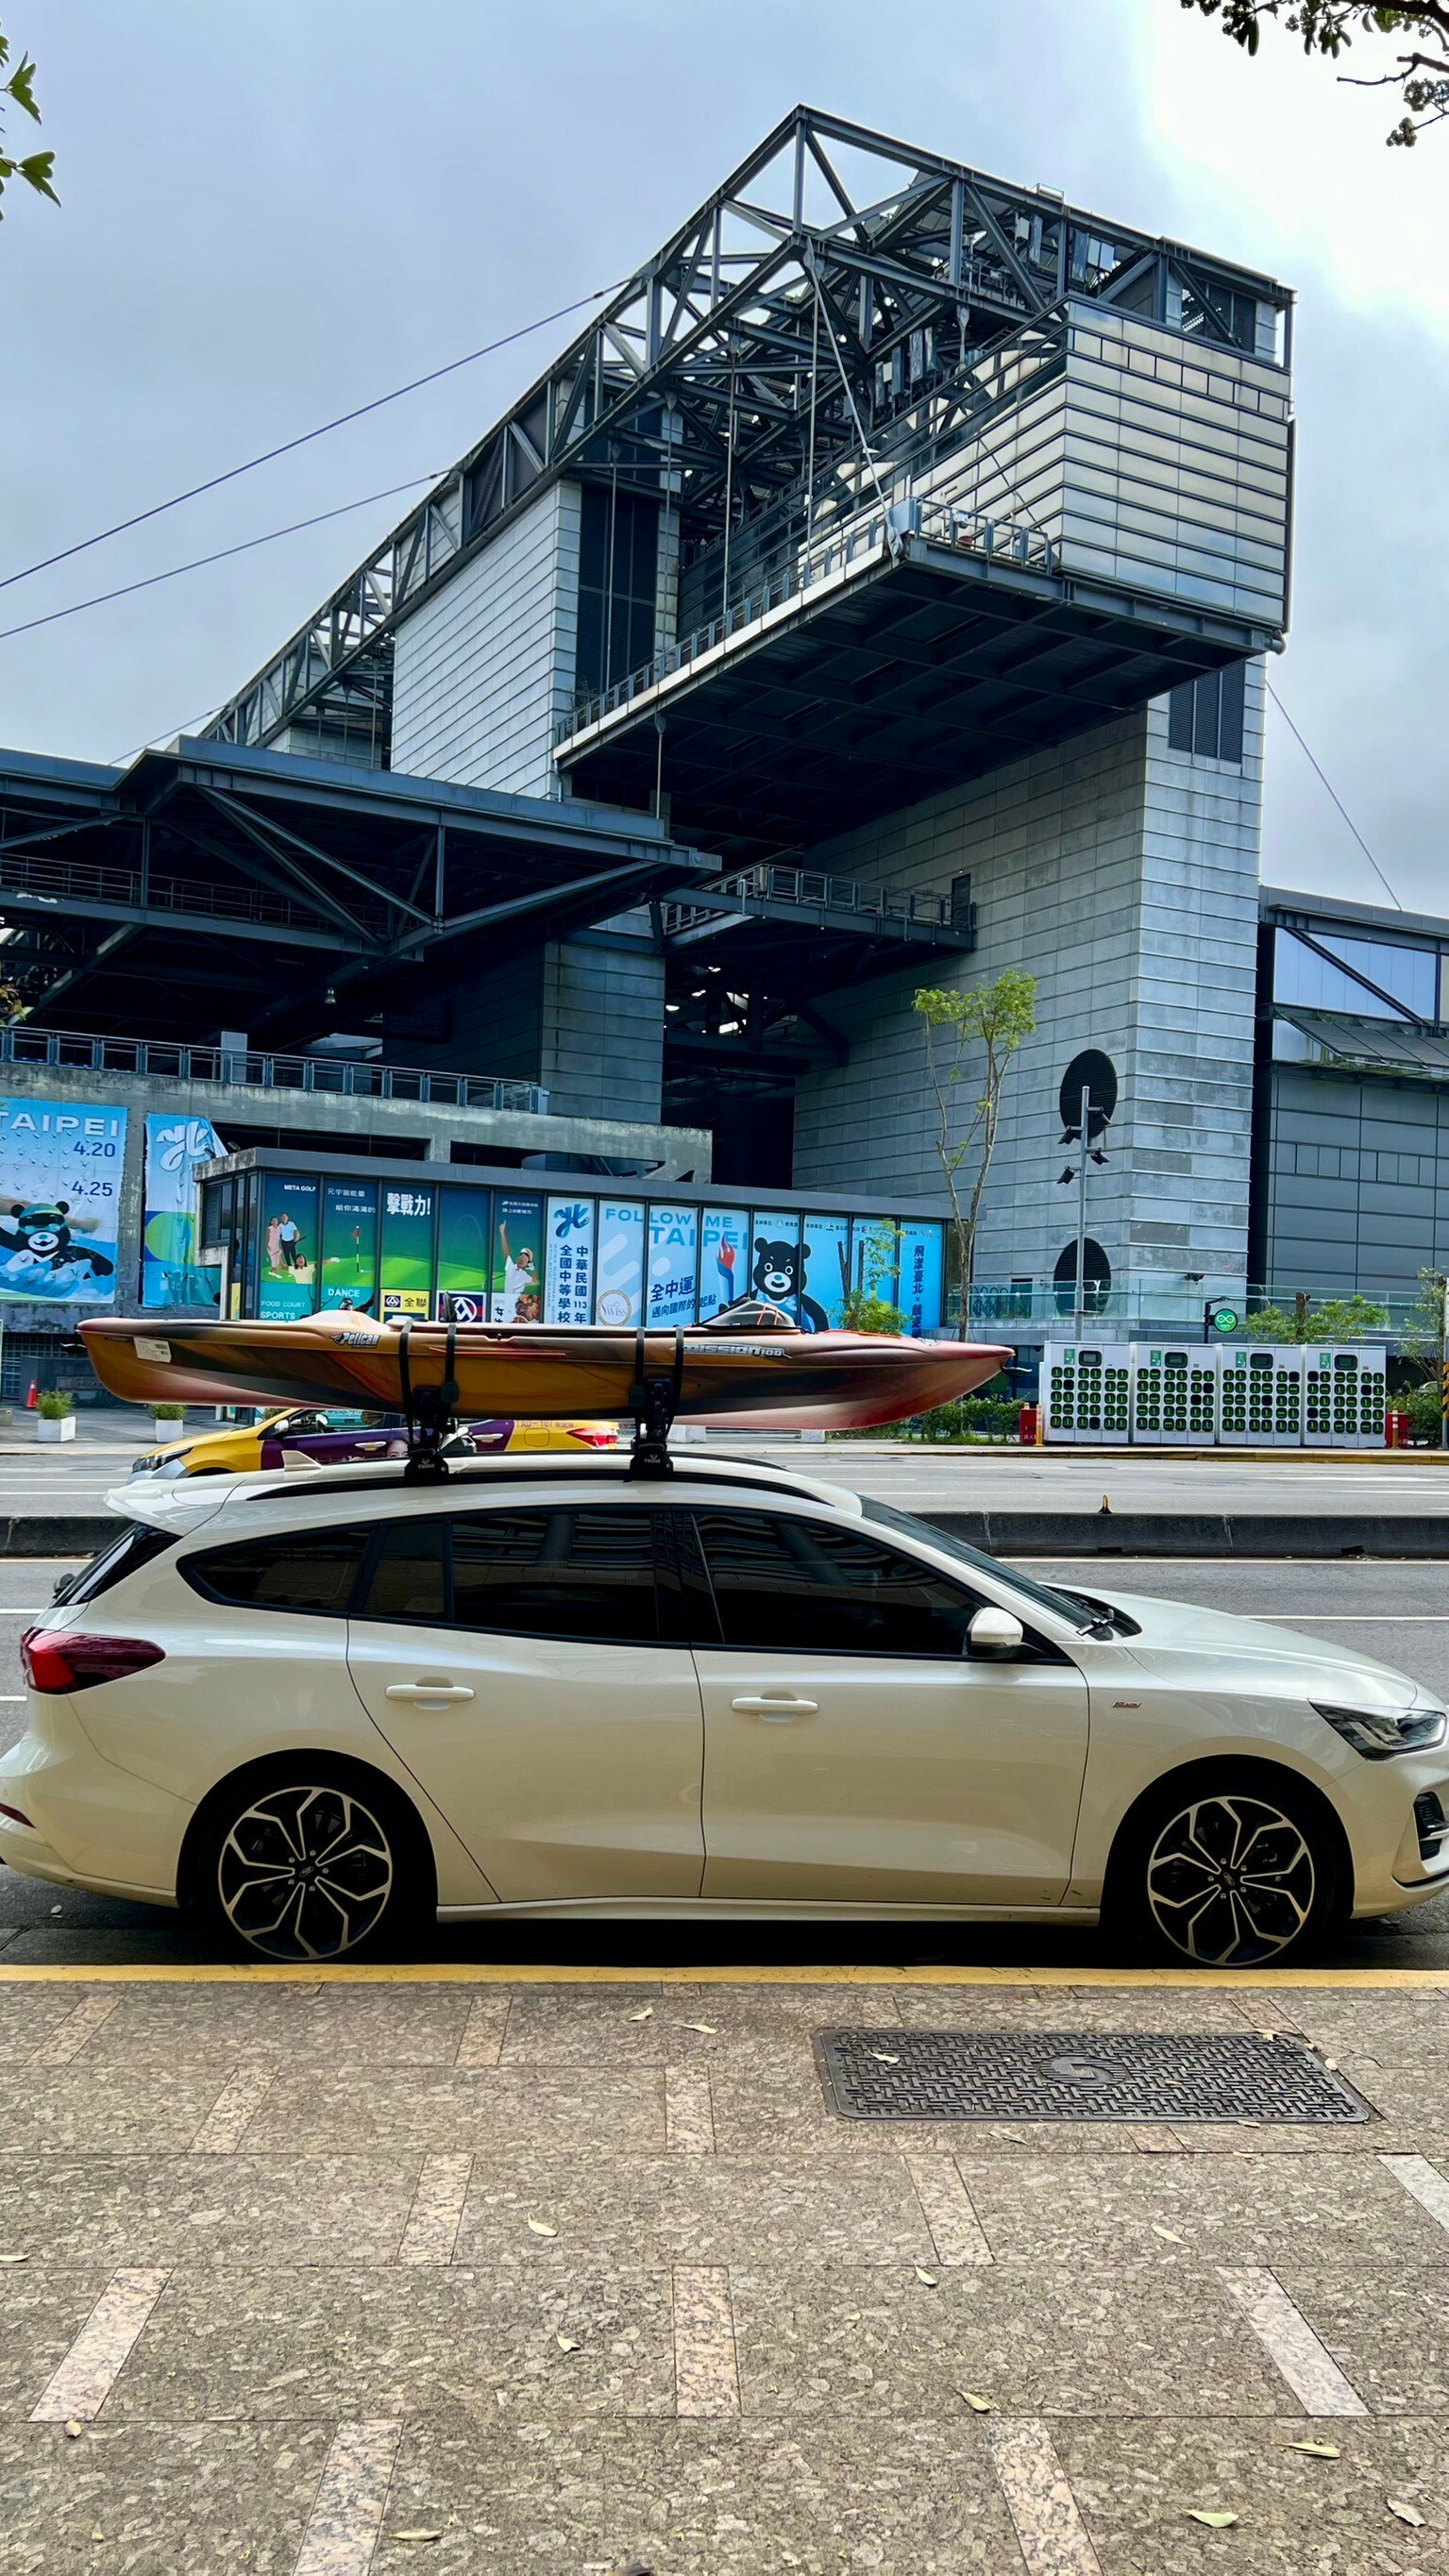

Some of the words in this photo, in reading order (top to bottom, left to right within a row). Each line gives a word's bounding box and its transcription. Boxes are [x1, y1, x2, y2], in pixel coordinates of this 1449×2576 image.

[74, 1141, 116, 1157] 4.20
[72, 1182, 113, 1197] 4.25
[605, 1208, 692, 1225] FOLLOW
[706, 1216, 733, 1228] ME
[649, 1226, 748, 1249] TAIPEI
[557, 1244, 572, 1323] 全國中等學校
[650, 1275, 696, 1303] 全中運
[328, 1288, 361, 1298] DANCE
[261, 1311, 295, 1321] SPORTS
[340, 1332, 379, 1345] Pelican
